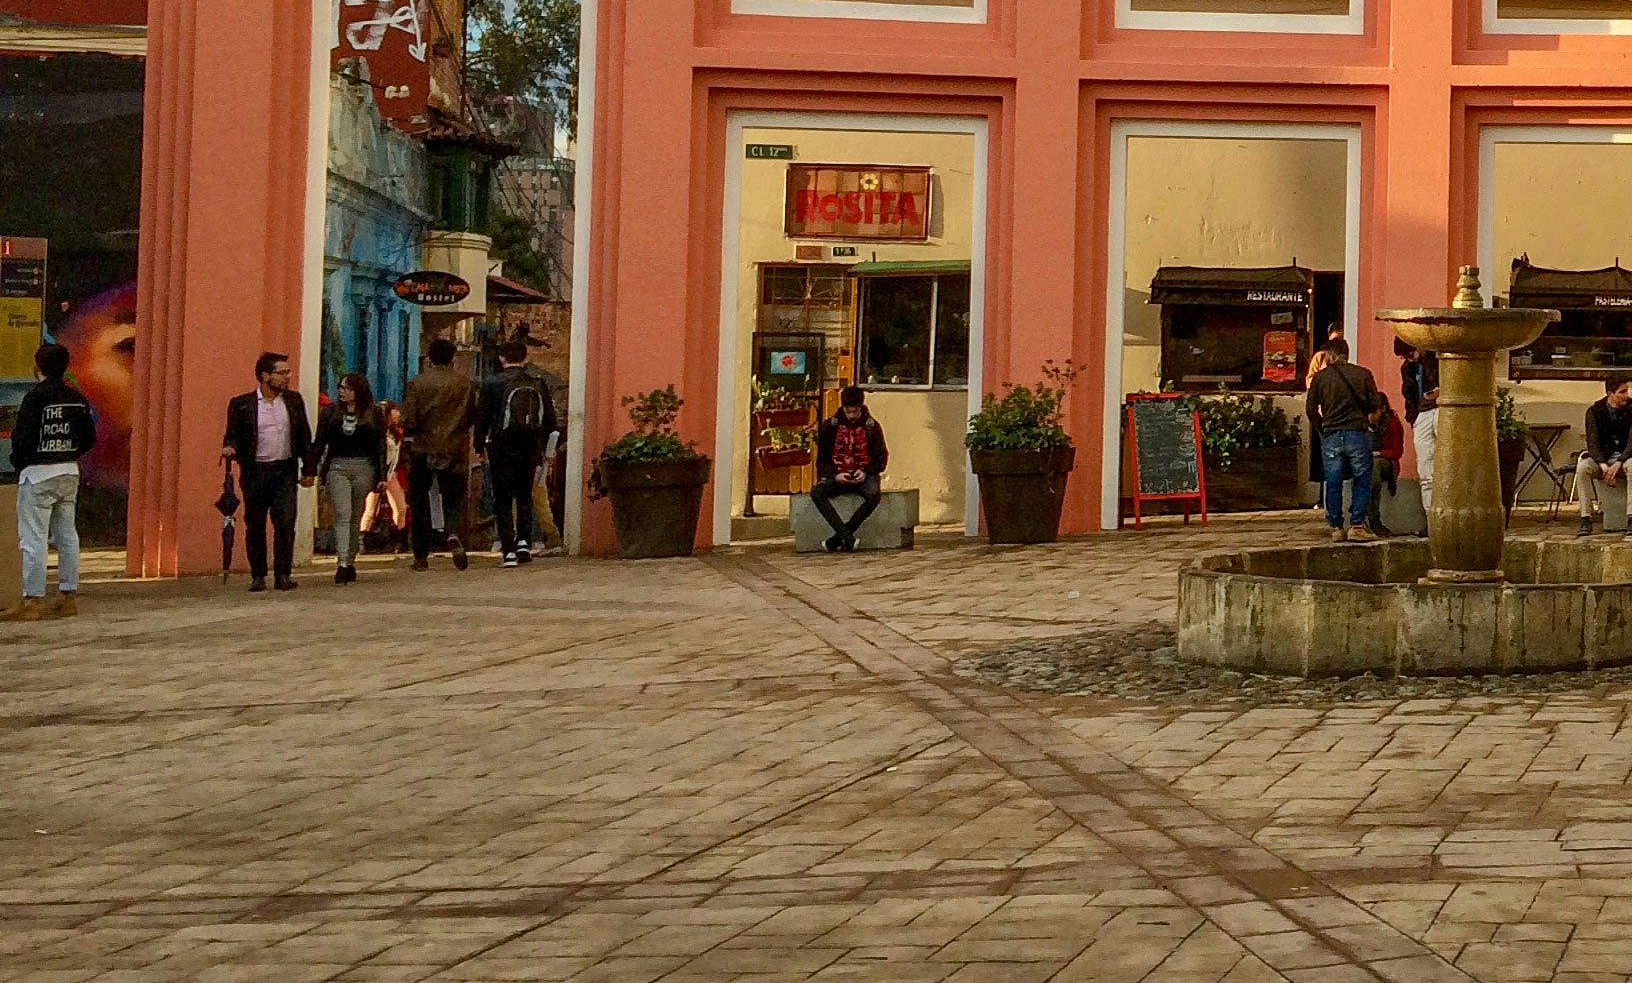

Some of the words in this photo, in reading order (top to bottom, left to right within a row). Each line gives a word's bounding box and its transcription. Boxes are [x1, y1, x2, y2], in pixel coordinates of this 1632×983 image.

[751, 146, 765, 157] CL
[796, 190, 920, 226] ROSITA
[1247, 290, 1303, 302] RESTAURANTE
[46, 407, 63, 419] THE
[43, 422, 71, 435] ROAD
[41, 438, 73, 451] URBAN
